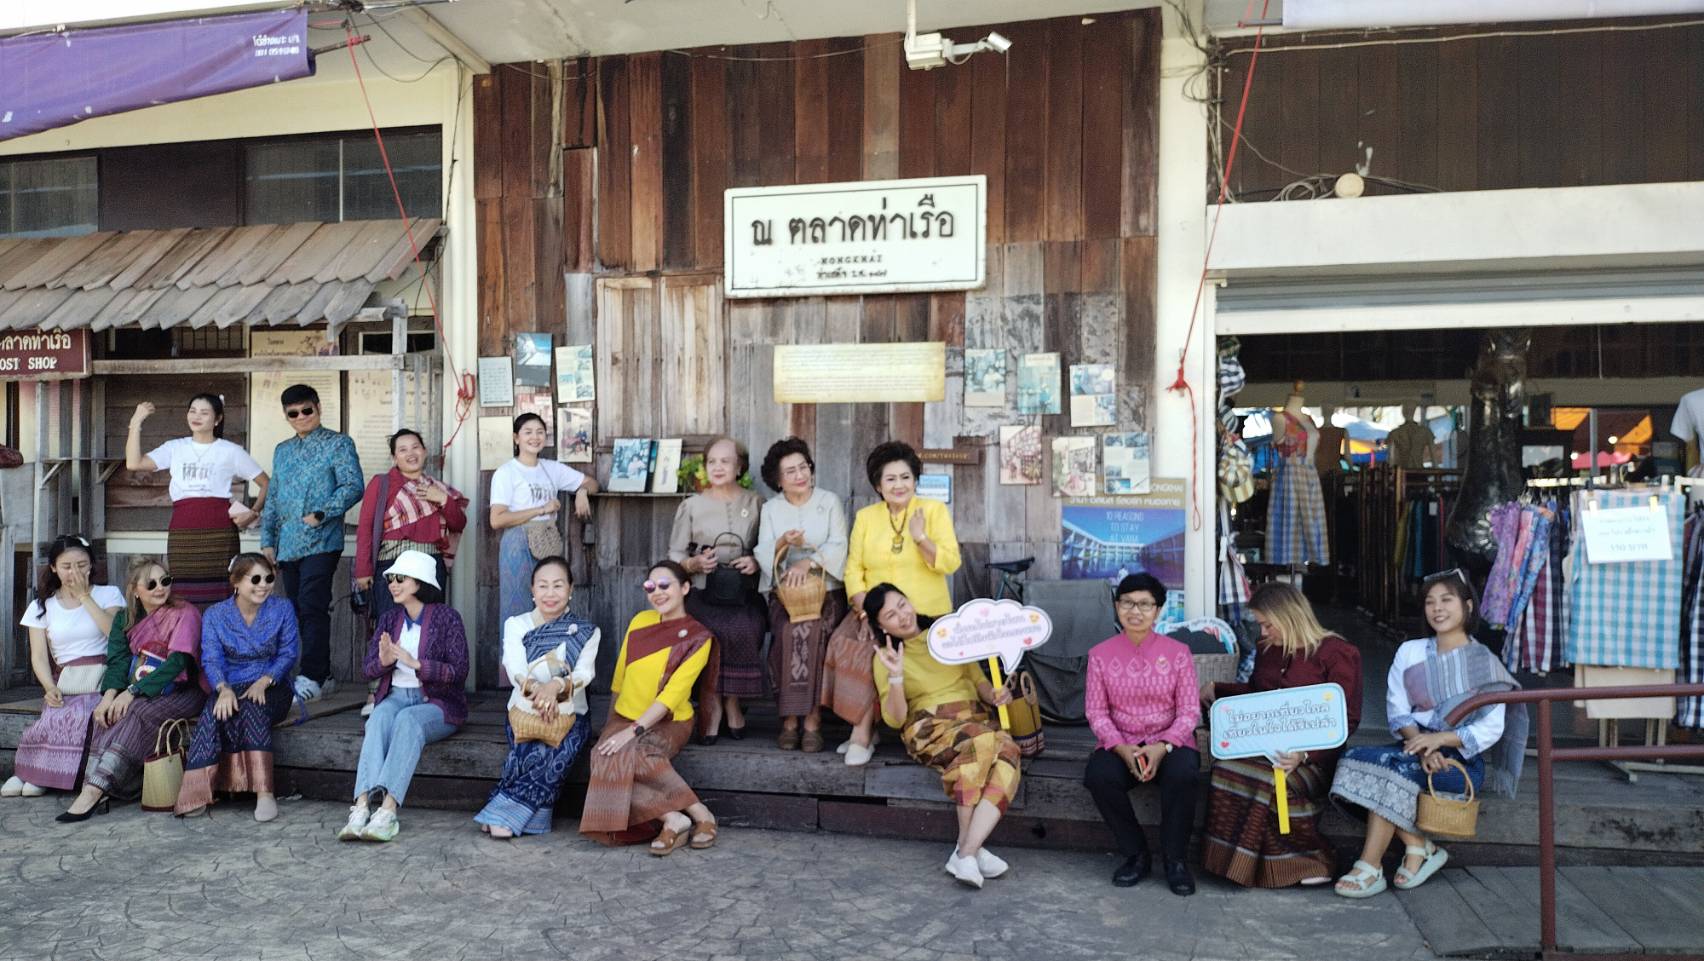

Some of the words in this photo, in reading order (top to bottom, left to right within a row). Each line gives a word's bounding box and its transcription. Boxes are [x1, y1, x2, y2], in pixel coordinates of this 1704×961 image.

[751, 218, 773, 246] ณ
[788, 194, 956, 245] ตลาดท่าเรือ
[0, 357, 20, 371] OST
[28, 356, 58, 370] SHOP
